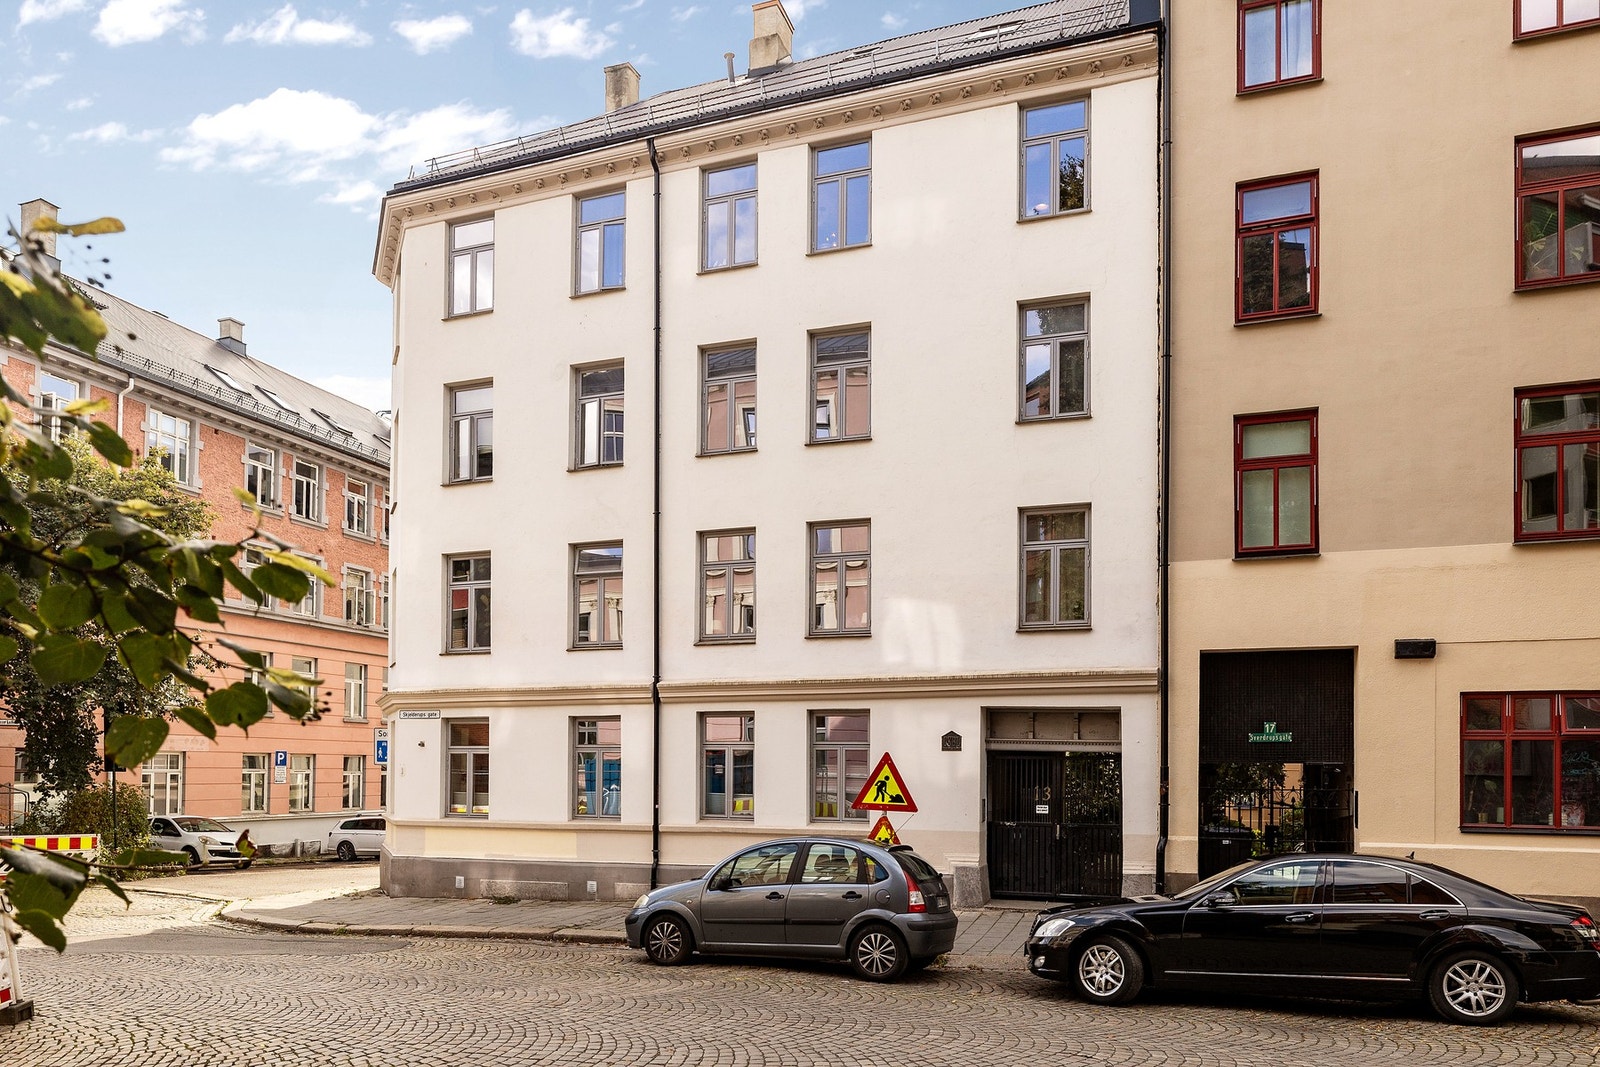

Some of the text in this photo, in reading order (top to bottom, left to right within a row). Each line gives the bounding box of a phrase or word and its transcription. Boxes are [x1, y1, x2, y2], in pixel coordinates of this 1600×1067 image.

[1265, 723, 1275, 733] 17
[277, 752, 285, 764] P
[1034, 785, 1051, 801] 13
